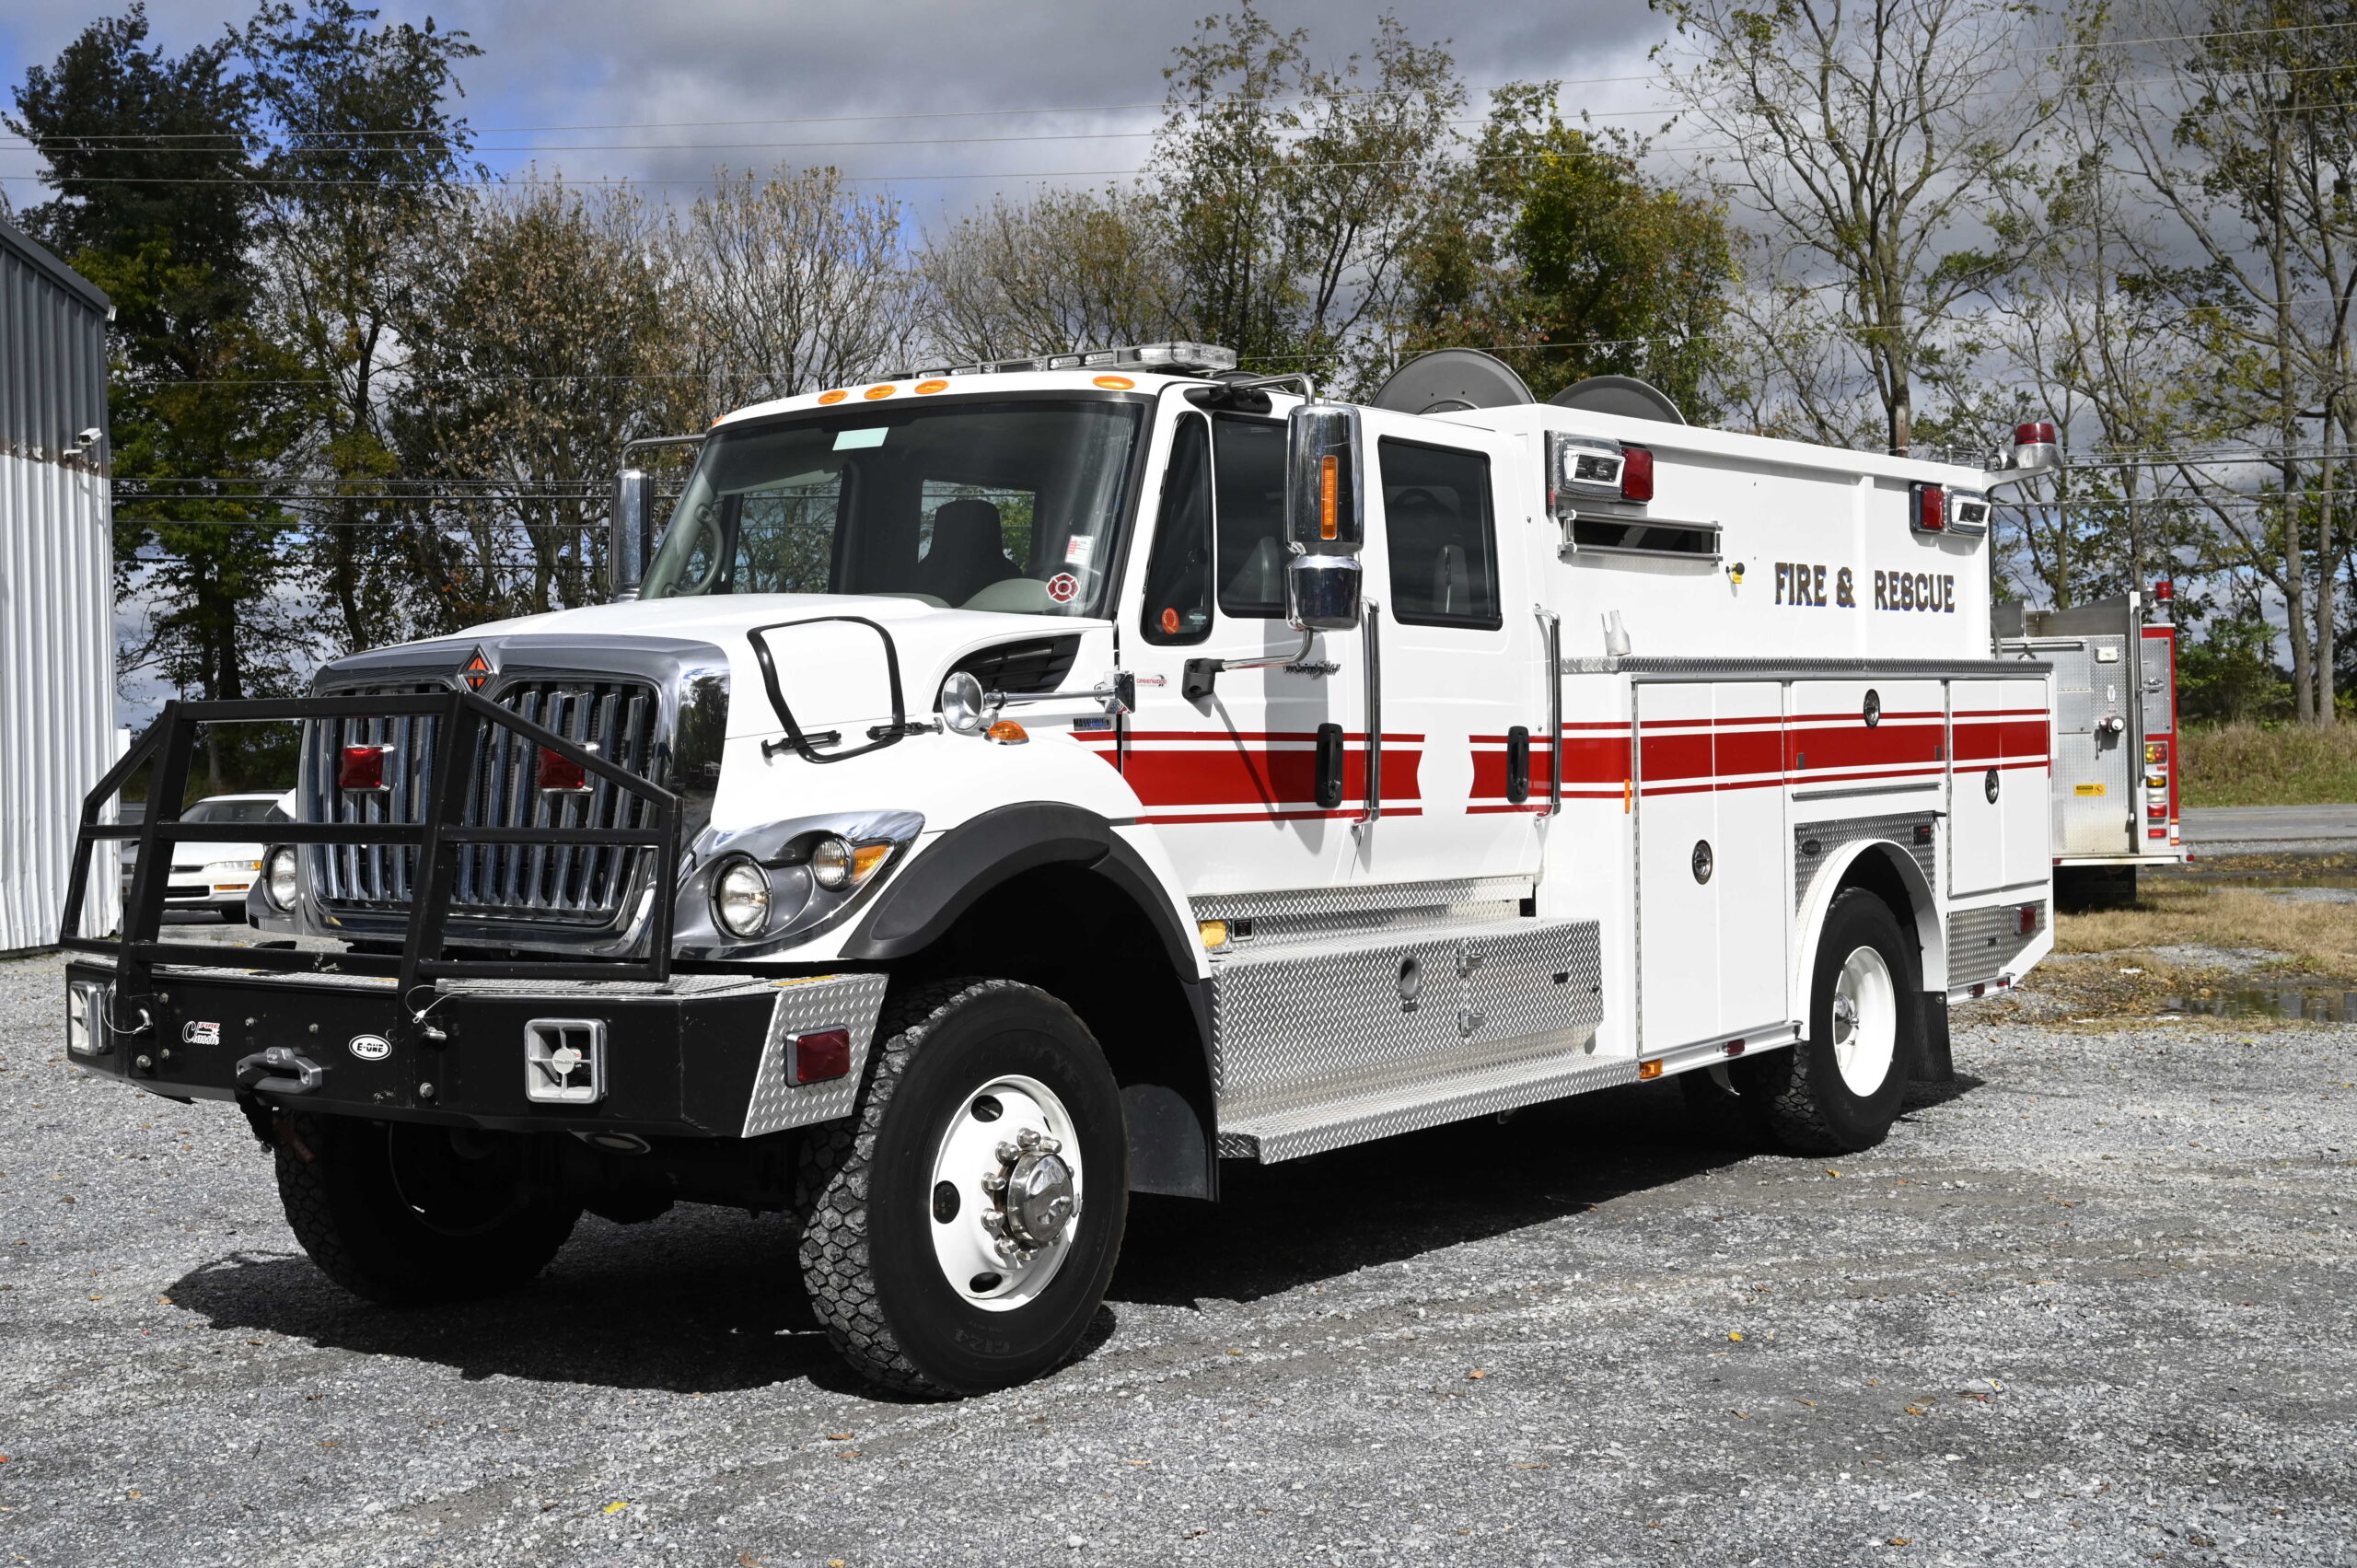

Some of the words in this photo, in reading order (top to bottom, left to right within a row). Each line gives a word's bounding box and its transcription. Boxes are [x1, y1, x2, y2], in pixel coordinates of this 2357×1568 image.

[1774, 562, 1828, 608] FIRE
[1836, 566, 1856, 608] &
[1875, 570, 1956, 613] RESCUE
[356, 1042, 385, 1053] E-ONE
